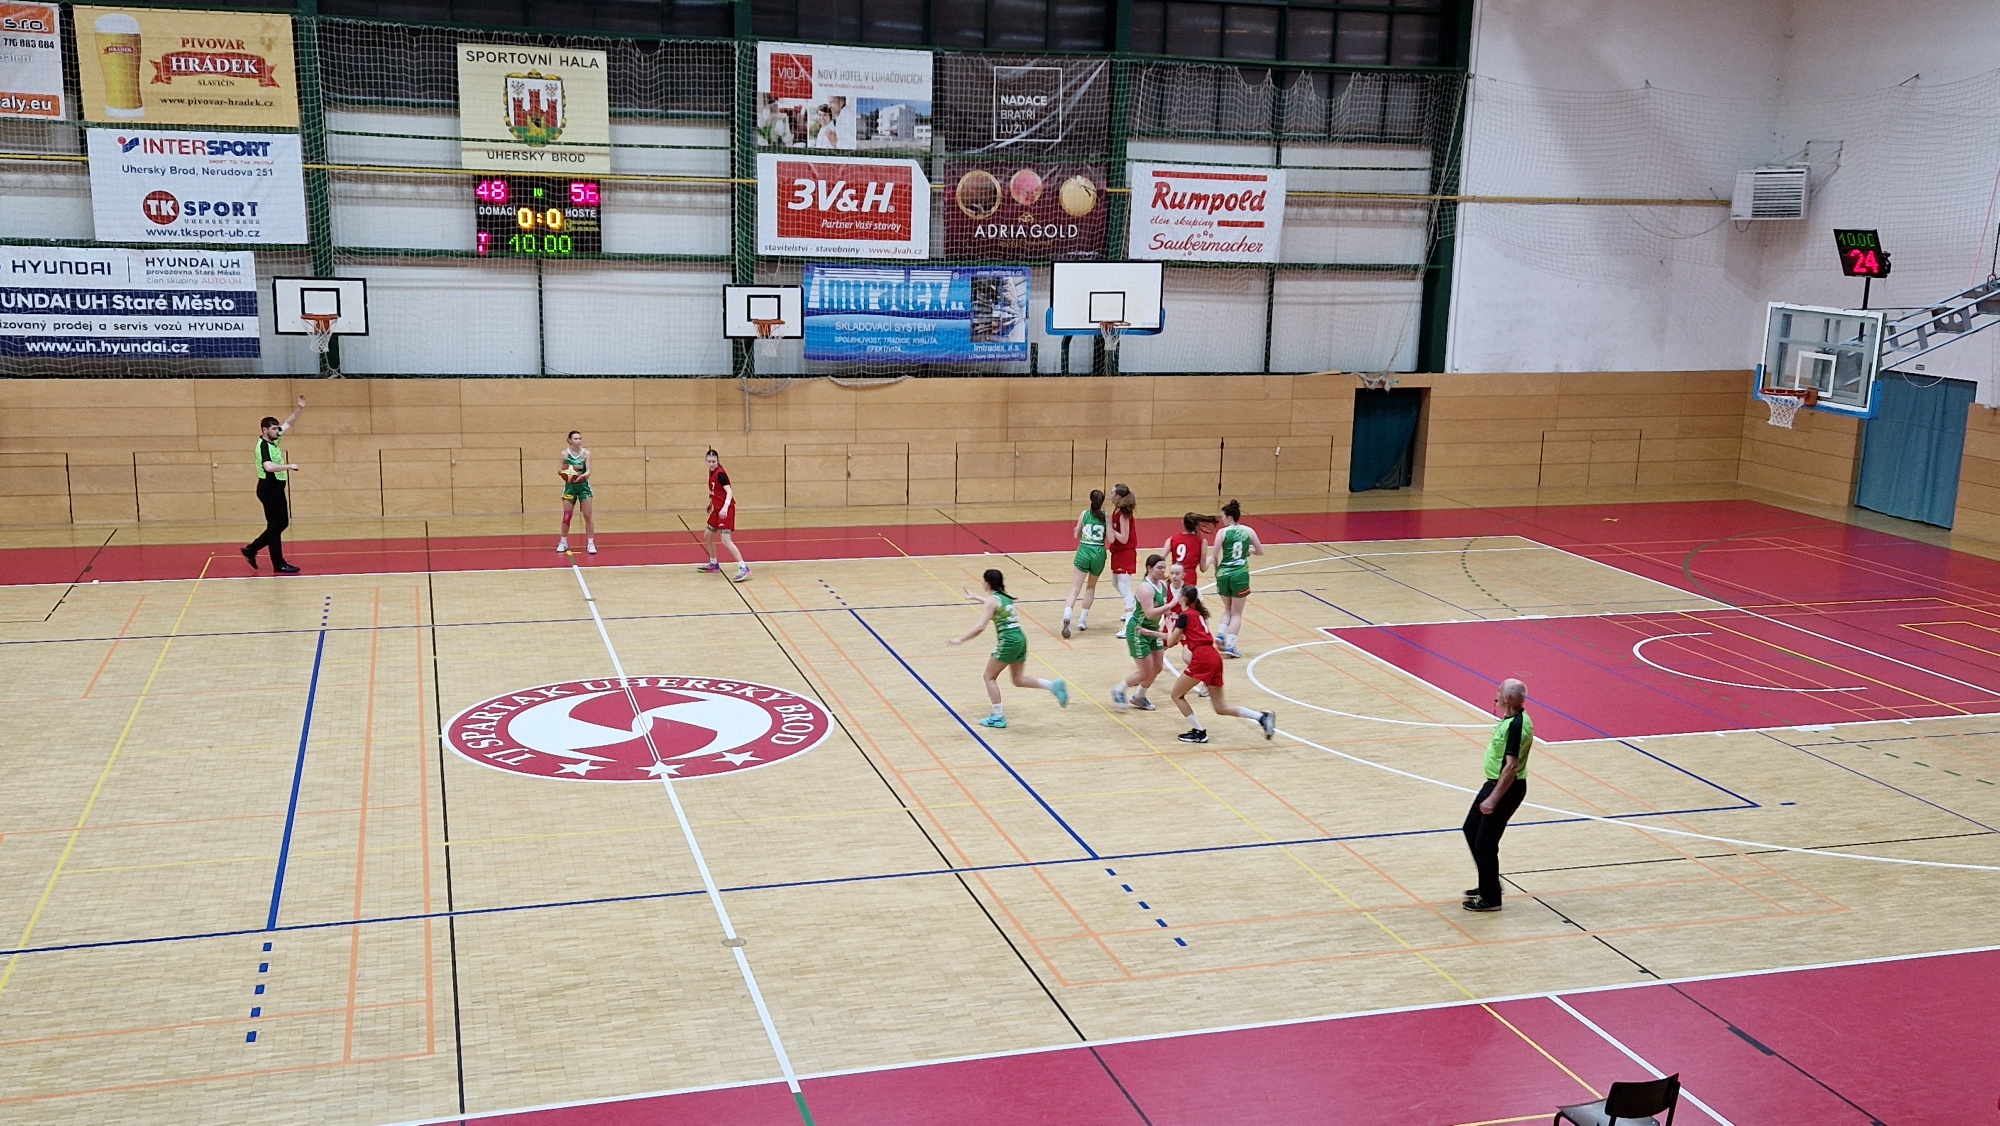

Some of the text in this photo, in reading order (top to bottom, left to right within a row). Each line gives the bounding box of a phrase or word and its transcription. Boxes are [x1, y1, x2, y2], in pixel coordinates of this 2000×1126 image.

[181, 37, 246, 50] PIVOVAR
[170, 55, 259, 74] HRÁDEK
[466, 50, 599, 69] SPORTOVNÍ HALA
[777, 66, 805, 79] VIOLA
[818, 68, 923, 84] NOVÝ HOTEL V LUHAČOVICÍCH
[160, 96, 274, 107] www.pivovar-hradek.cz
[1000, 94, 1048, 106] NADACE
[1000, 107, 1036, 119] BRATŘÍ
[143, 137, 271, 156] INTERSPORT
[551, 153, 585, 163] BROD
[121, 165, 273, 177] Uherský Brod, Nerudova 251
[476, 180, 505, 200] 48
[570, 183, 599, 202] 56
[1151, 181, 1267, 215] Rumpold
[146, 200, 258, 217] TK SPORT
[479, 204, 516, 216] DOMÁCÍ
[821, 219, 854, 229] Partner
[873, 222, 901, 233] stavby
[1150, 215, 1214, 229] člen skupiny
[146, 227, 260, 239] www.tksport-ub.cz
[508, 233, 572, 252] 10.00
[1149, 232, 1264, 253] Saubermacher
[869, 247, 923, 255] www.3vah.cz
[12, 260, 111, 276] HYUNDAI
[145, 257, 240, 268] HYUNDAI UH
[1849, 249, 1879, 273] 24
[167, 276, 199, 285] skupiny
[201, 277, 227, 285] AUTO
[76, 294, 107, 310] UH
[112, 293, 167, 310] Staré
[172, 294, 235, 312] Město
[53, 321, 92, 332] prodej
[99, 323, 107, 331] a
[113, 320, 148, 331] servis
[154, 319, 182, 331] vozů
[188, 322, 244, 332] HYUNDAI
[835, 320, 937, 332] SKLADOVACÍ SYSTÉMY
[25, 339, 189, 355] www.uh.hyundai.cz
[1082, 524, 1105, 541] 43
[1176, 543, 1187, 562] 9
[1232, 541, 1243, 560] 8
[461, 677, 814, 766] TJ SPARTAK UHERSKÝ BROD
